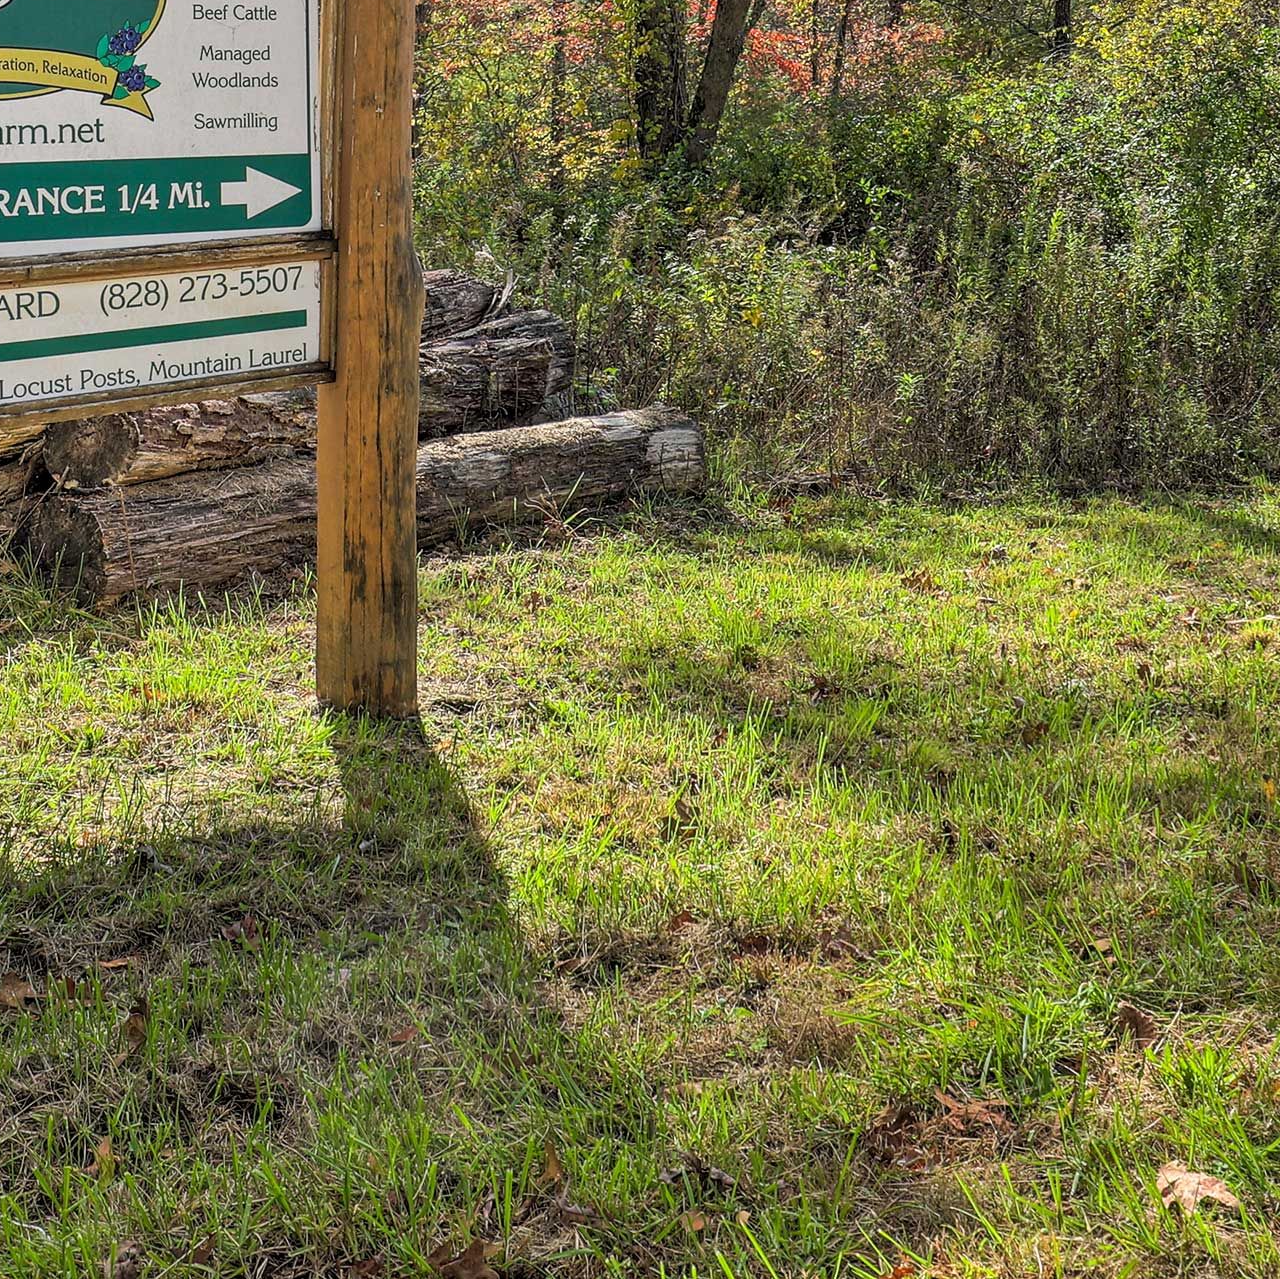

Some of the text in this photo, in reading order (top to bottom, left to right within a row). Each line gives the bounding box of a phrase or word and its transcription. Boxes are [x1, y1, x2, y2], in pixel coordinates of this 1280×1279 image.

[192, 4, 277, 21] Beef Cattle
[199, 45, 270, 65] Managed
[42, 60, 108, 85] Relaxation
[192, 72, 278, 88] Woodlands
[194, 113, 278, 131] Sawmilling
[117, 183, 159, 213] 1/4
[168, 182, 210, 210] Mi.
[100, 279, 169, 317] (828)
[179, 266, 303, 303] 273-5507
[0, 376, 73, 400] Locust
[80, 367, 140, 391] Posts,
[148, 353, 242, 381] Mountain
[249, 343, 307, 368] Laurel
